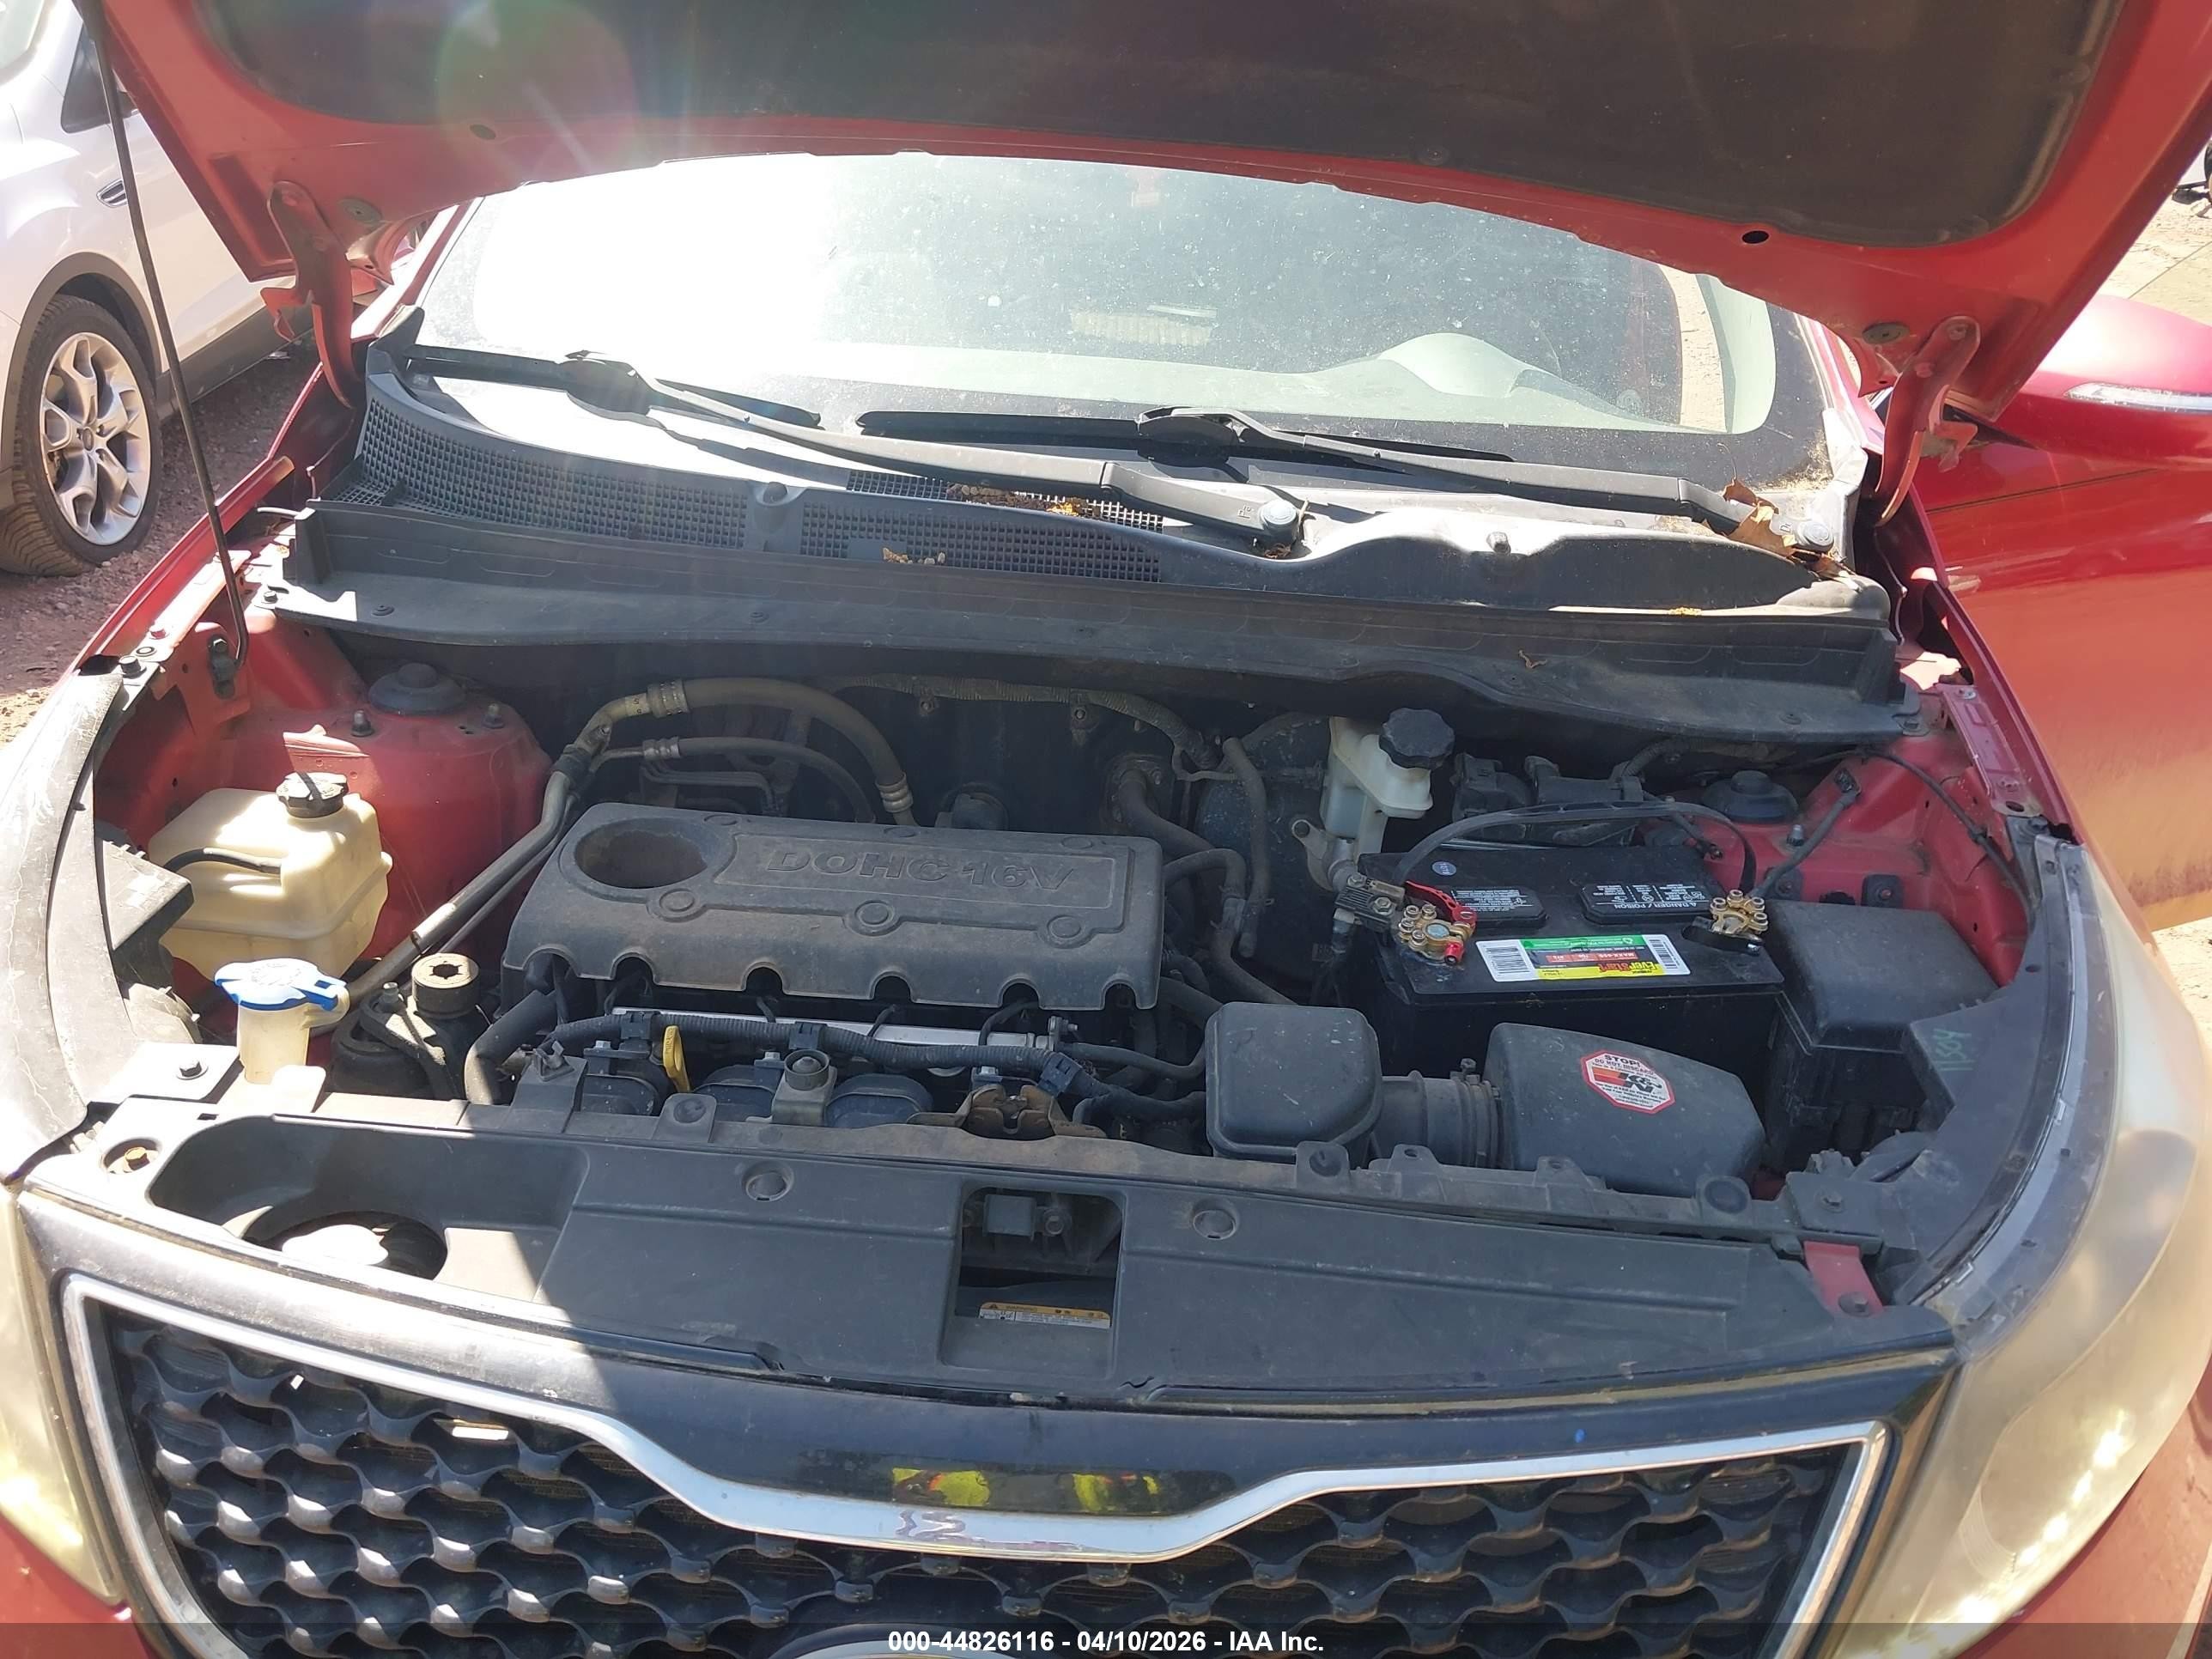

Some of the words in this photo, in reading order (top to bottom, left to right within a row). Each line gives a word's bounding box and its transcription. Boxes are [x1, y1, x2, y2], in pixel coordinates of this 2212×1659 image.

[766, 851, 951, 882] DOHC
[961, 861, 1074, 890] 16V
[1598, 961, 1660, 973] EverStart
[1604, 1054, 1641, 1067] STOP!
